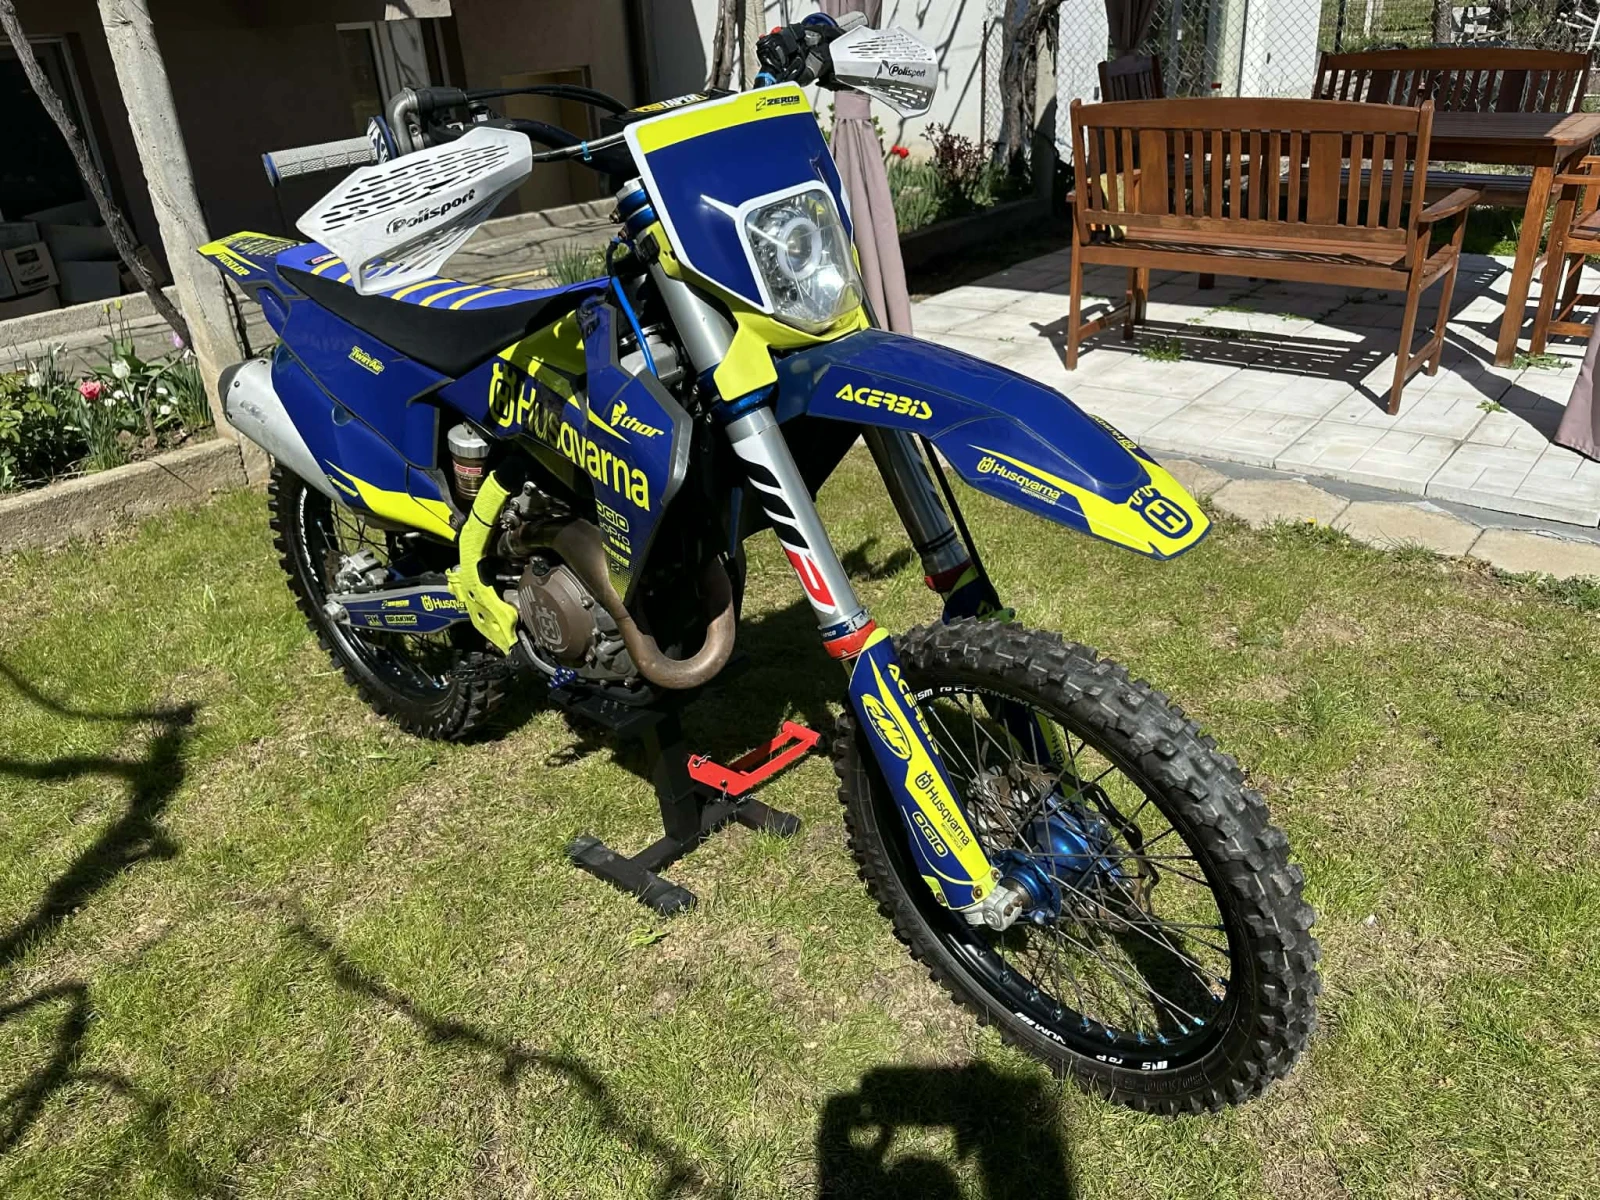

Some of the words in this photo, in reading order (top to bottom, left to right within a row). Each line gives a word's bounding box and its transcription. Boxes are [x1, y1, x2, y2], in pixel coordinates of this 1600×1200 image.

[889, 64, 926, 78] Polisport
[766, 95, 800, 106] ZEROS
[389, 189, 476, 233] Polisport
[215, 252, 251, 276] DUNLOP
[835, 383, 933, 420] ACERBIS
[620, 416, 665, 438] thor
[516, 382, 651, 512] Husqvarna
[991, 463, 1061, 500] Husqvarna
[599, 521, 630, 547] oPro
[862, 697, 911, 757] FMF
[887, 663, 940, 756] ACERBIS
[912, 811, 949, 858] OGIO
[925, 786, 971, 847] Husqvarna
